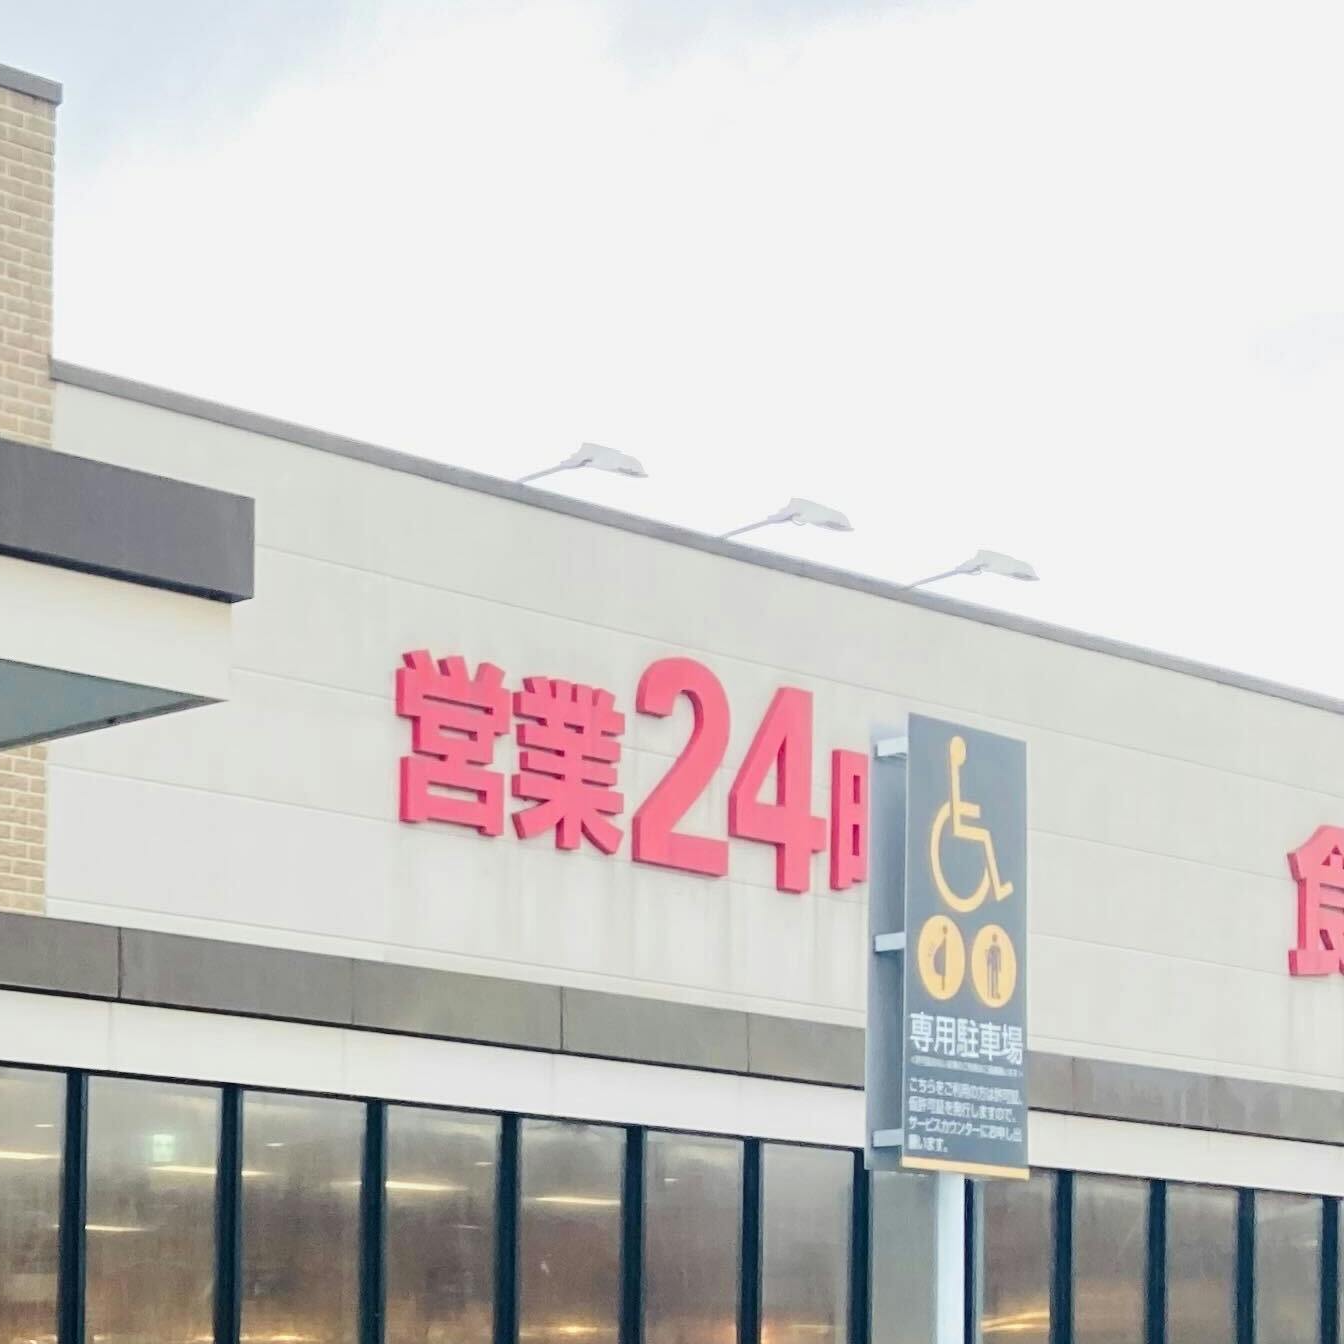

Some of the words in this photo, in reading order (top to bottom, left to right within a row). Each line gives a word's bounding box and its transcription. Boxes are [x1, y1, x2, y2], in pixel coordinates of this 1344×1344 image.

[910, 1011, 1023, 1065] 専用駐車場
